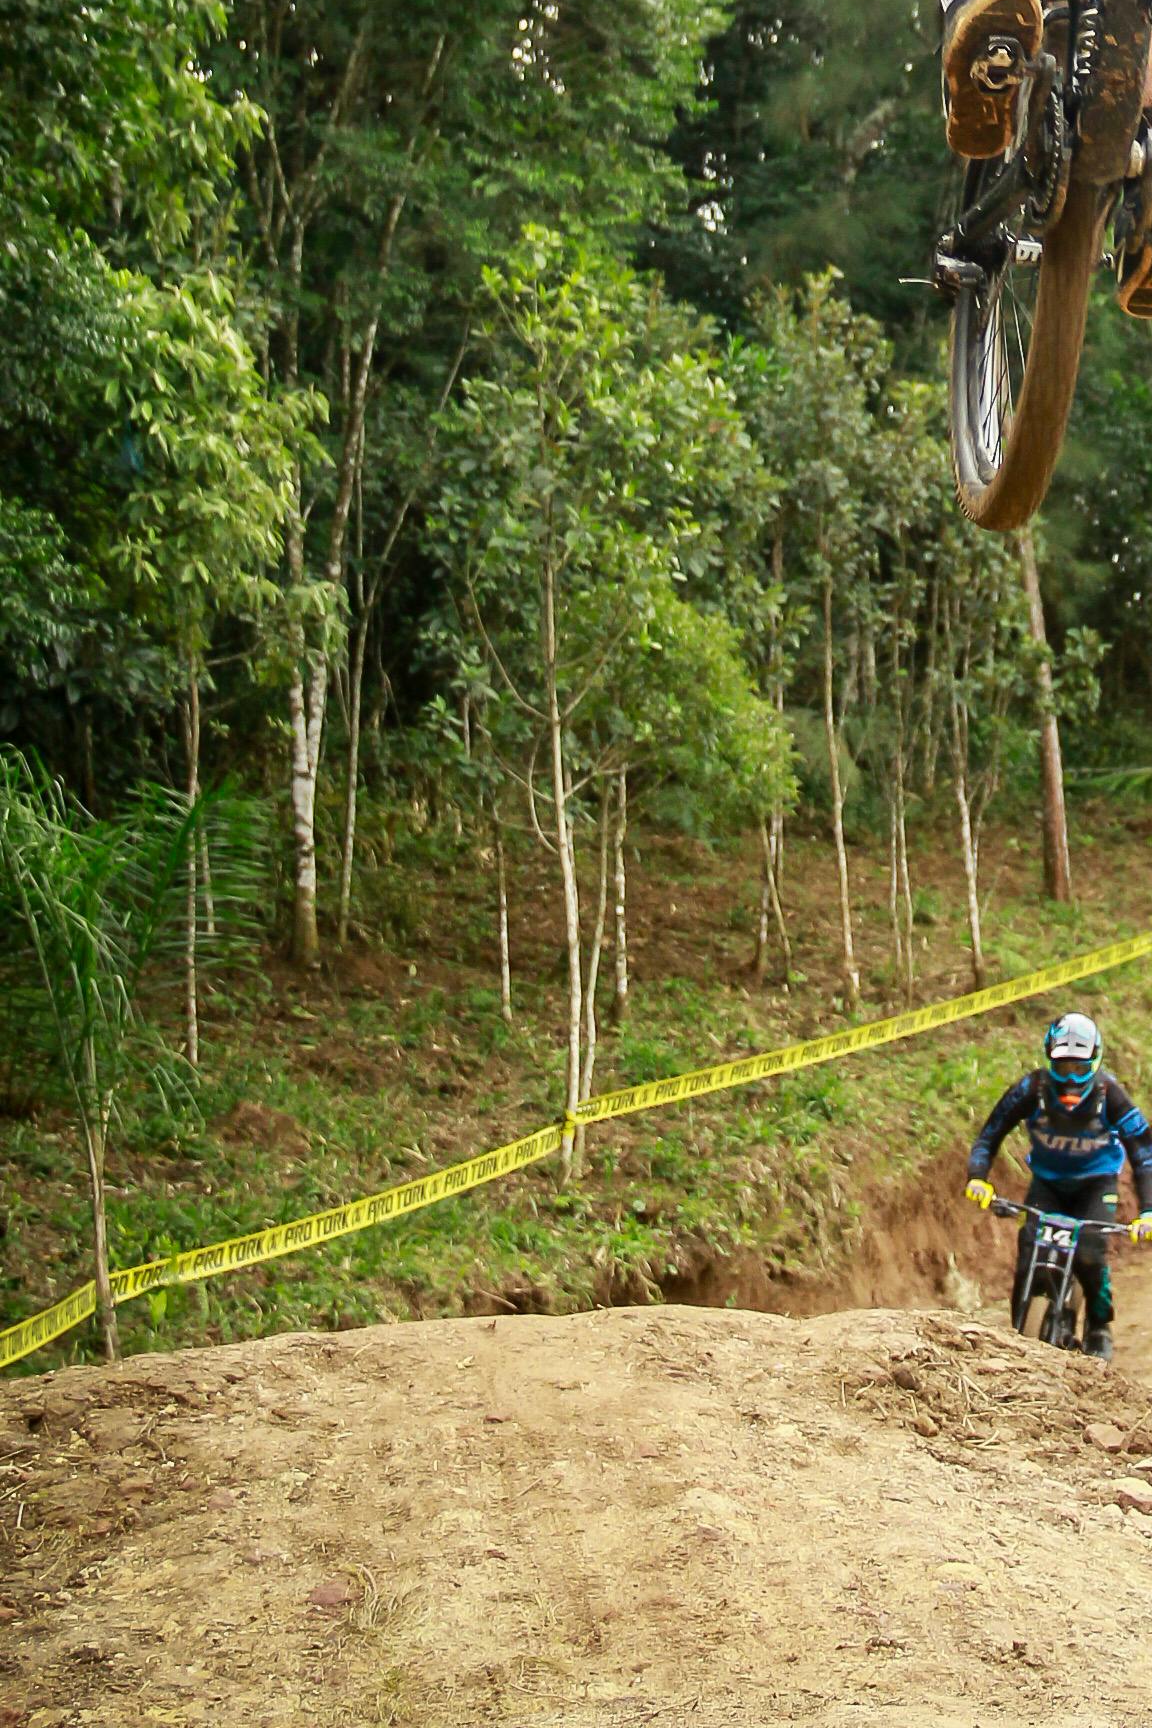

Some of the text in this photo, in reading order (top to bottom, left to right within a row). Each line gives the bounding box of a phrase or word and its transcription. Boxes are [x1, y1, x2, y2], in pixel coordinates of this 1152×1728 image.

[133, 1264, 164, 1291] TOR
[193, 1247, 225, 1272] PRO
[229, 1238, 263, 1264] TORK
[284, 1222, 313, 1248] PRO
[316, 1209, 349, 1238] TORK
[367, 1194, 394, 1221] PRO
[397, 1183, 427, 1210] TORK
[444, 1168, 468, 1193] PRO
[471, 1155, 500, 1179] TORK
[514, 1138, 538, 1162] PRO
[1042, 1225, 1072, 1246] 14
